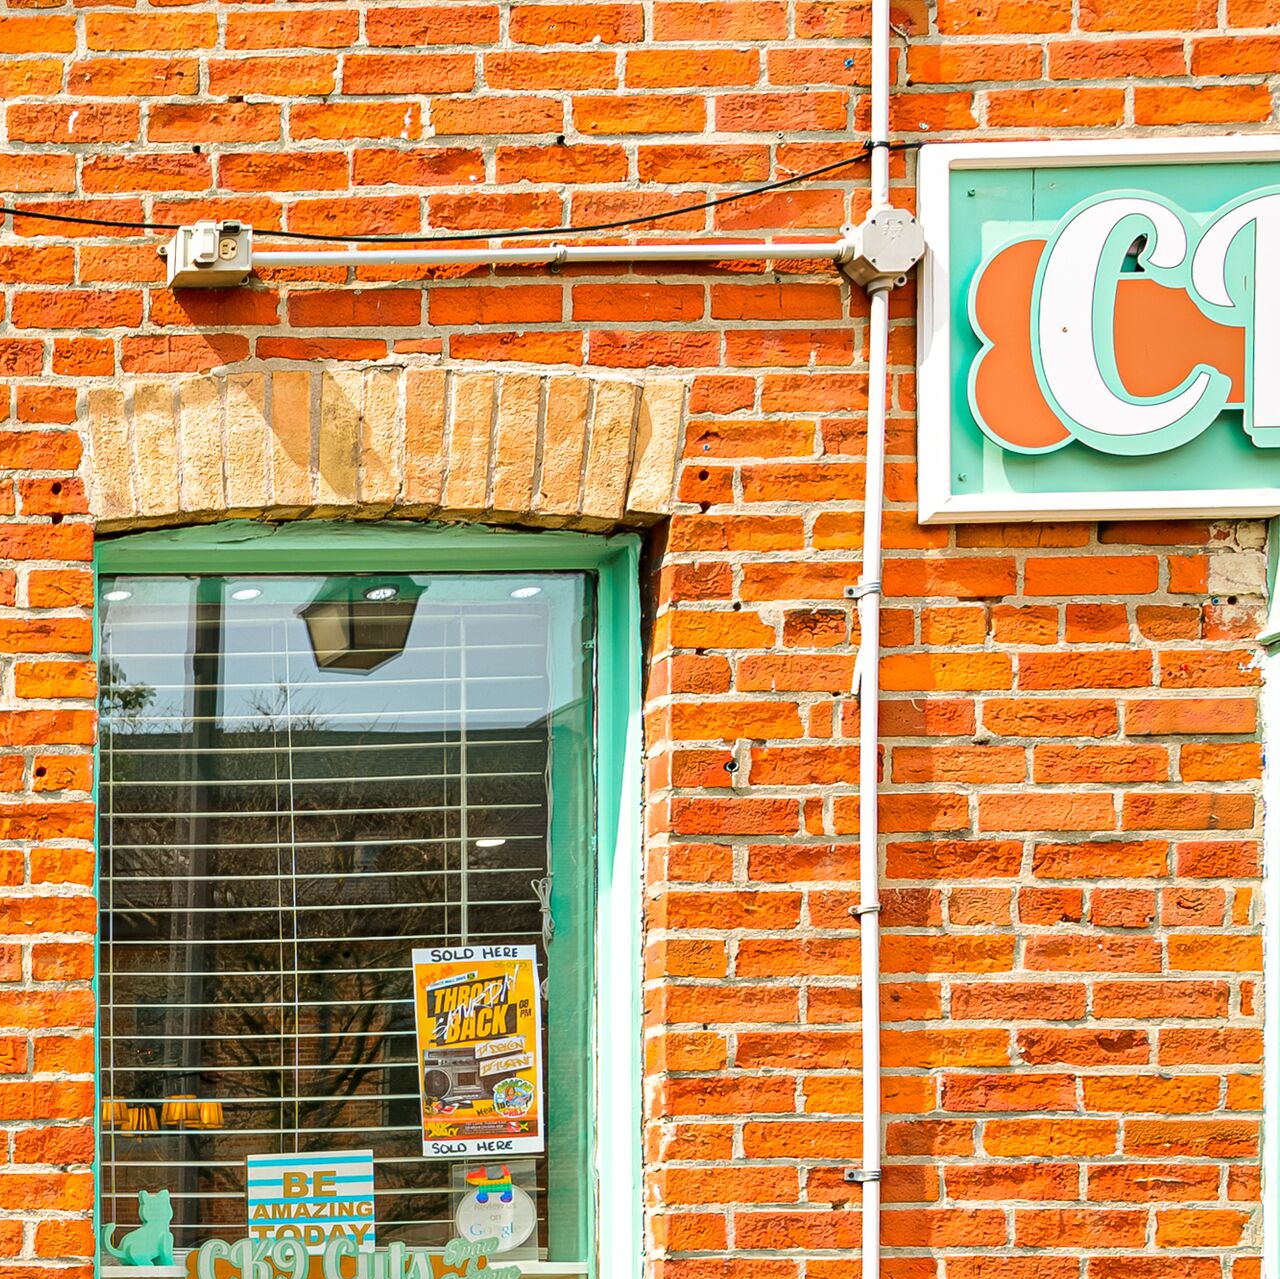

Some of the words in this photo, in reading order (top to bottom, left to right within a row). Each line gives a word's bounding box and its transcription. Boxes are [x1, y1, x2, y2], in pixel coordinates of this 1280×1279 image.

[430, 948, 474, 962] SOLD
[482, 947, 518, 959] HERE
[446, 1003, 508, 1043] BACK
[431, 1142, 467, 1154] SOLD
[477, 1140, 513, 1152] HERE
[282, 1170, 337, 1199] BE
[251, 1201, 373, 1219] AMAZING
